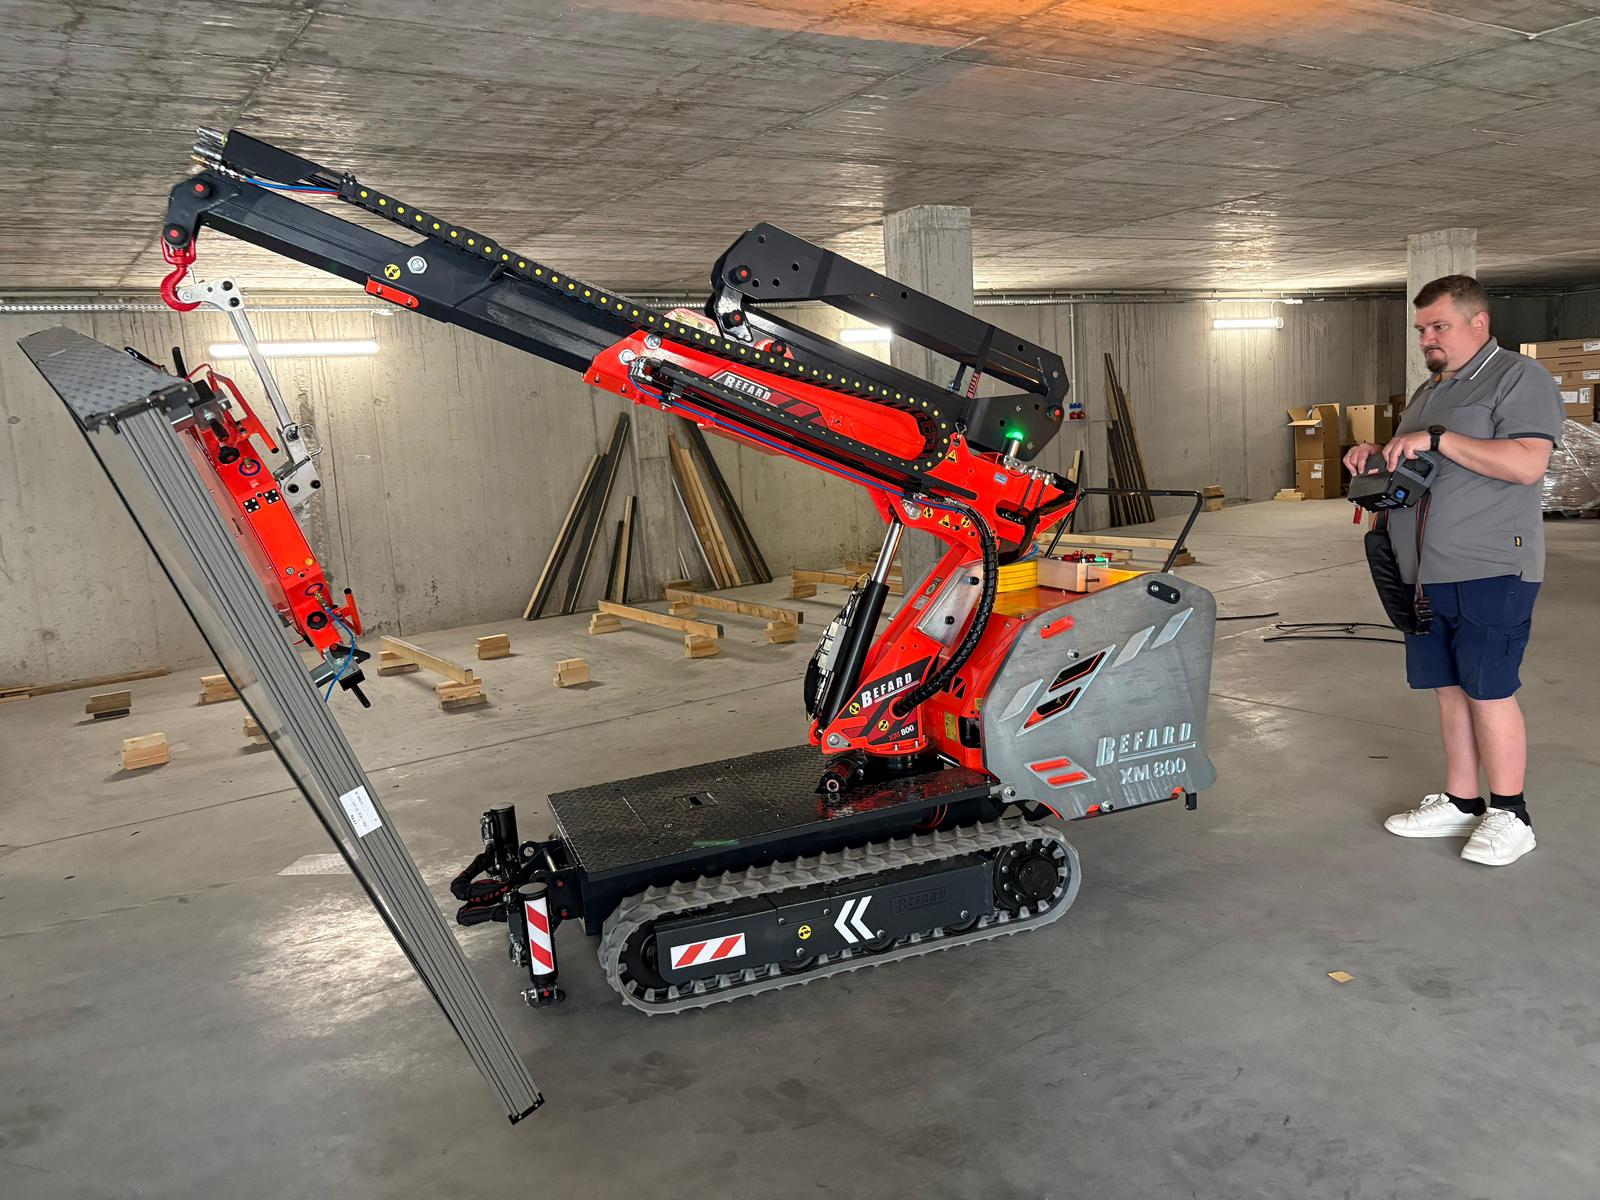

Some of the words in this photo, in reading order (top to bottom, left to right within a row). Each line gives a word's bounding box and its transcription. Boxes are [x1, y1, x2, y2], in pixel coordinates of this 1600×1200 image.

[861, 672, 912, 708] BEFARD
[900, 724, 915, 737] 800
[1096, 722, 1192, 767] BEFARD
[1119, 763, 1151, 785] XM
[1152, 757, 1187, 778] 800
